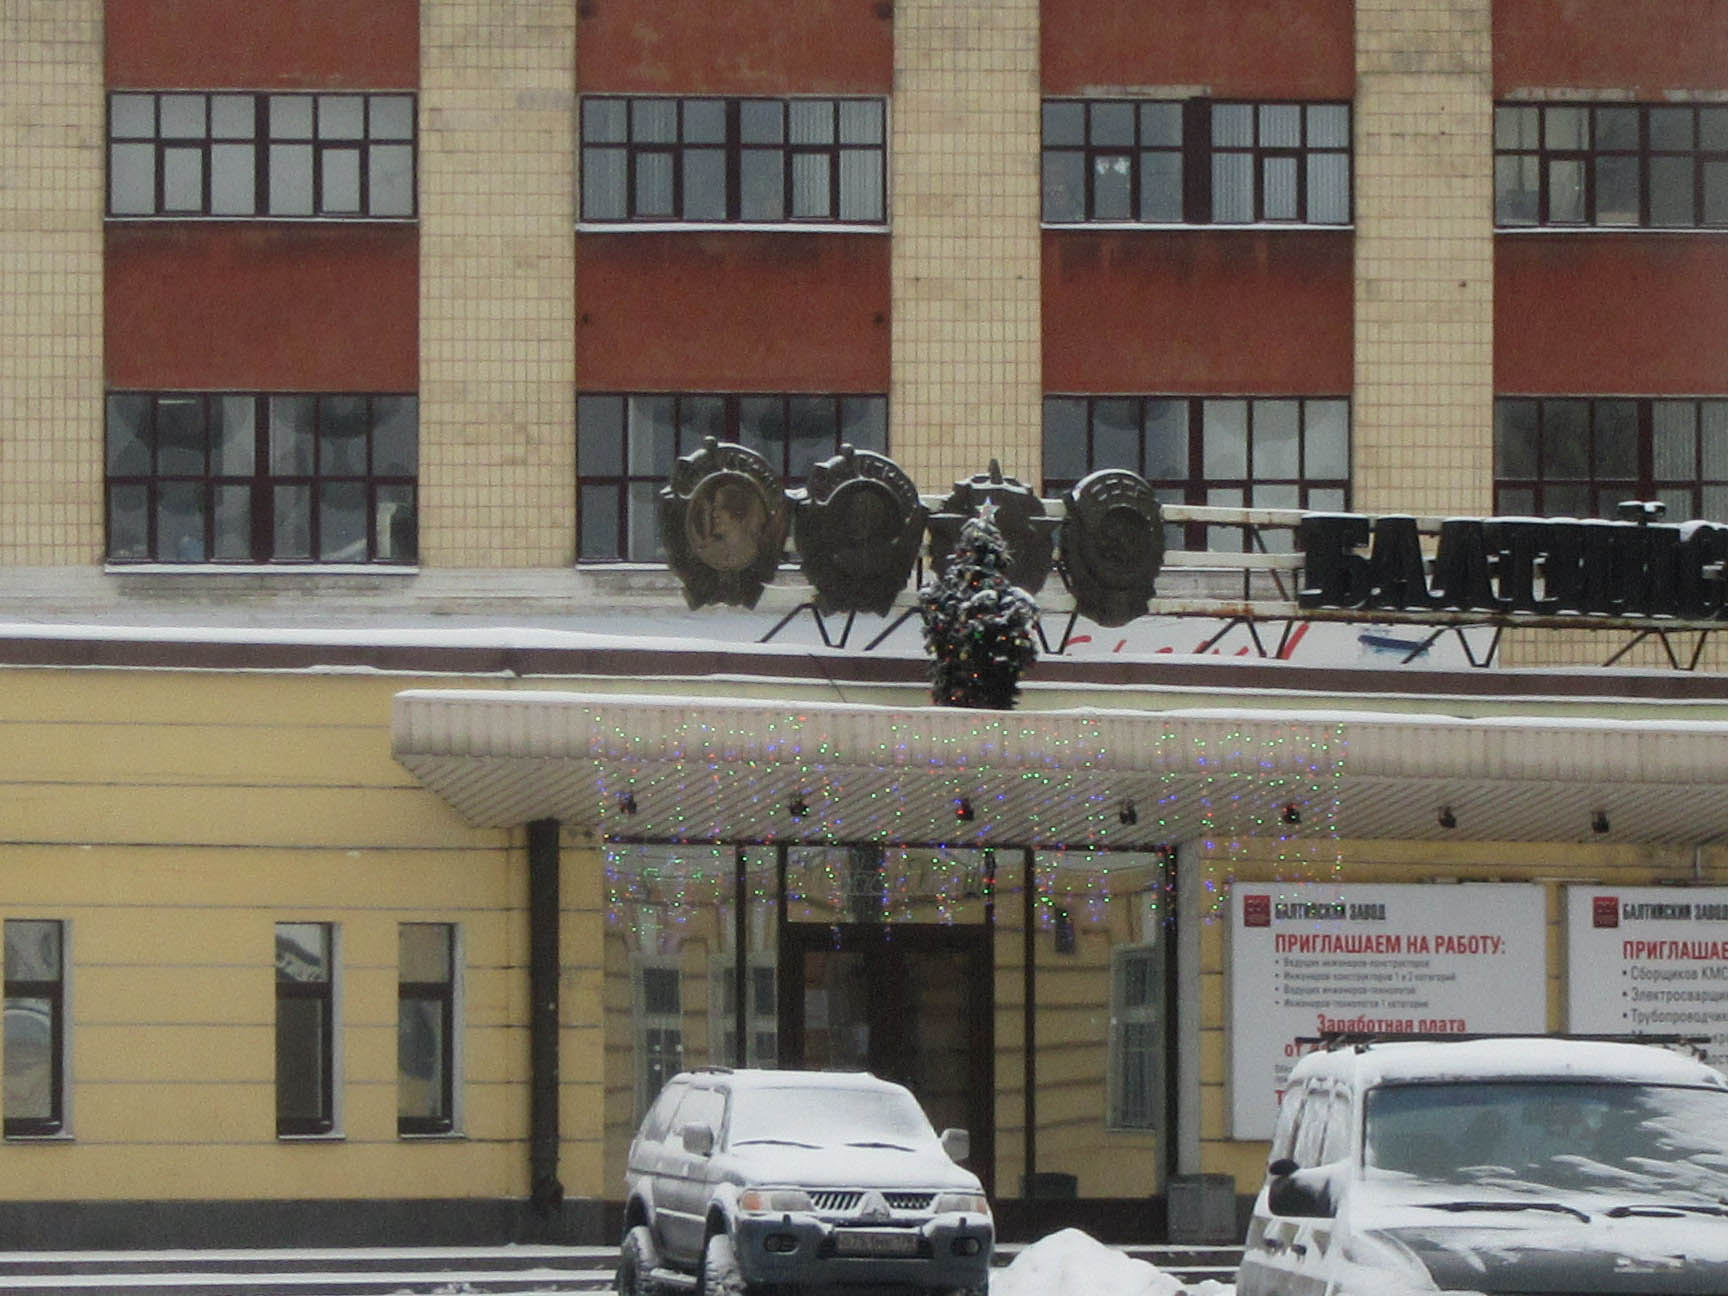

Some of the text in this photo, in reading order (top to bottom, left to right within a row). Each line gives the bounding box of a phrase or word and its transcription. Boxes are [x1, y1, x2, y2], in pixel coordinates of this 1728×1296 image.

[1275, 904, 1346, 920] БАЛТИЙСКИЙ
[1349, 904, 1386, 920] ЗАВОД
[1623, 904, 1691, 920] БАЛТИЙСКИЙ
[1694, 904, 1728, 920] ЗАВОД
[1275, 934, 1506, 954] ПРИГЛАШАЕМ НА РАБОТУ:
[1630, 966, 1728, 981] Сборщиков КМС
[1317, 1014, 1466, 1034] Заработная плата
